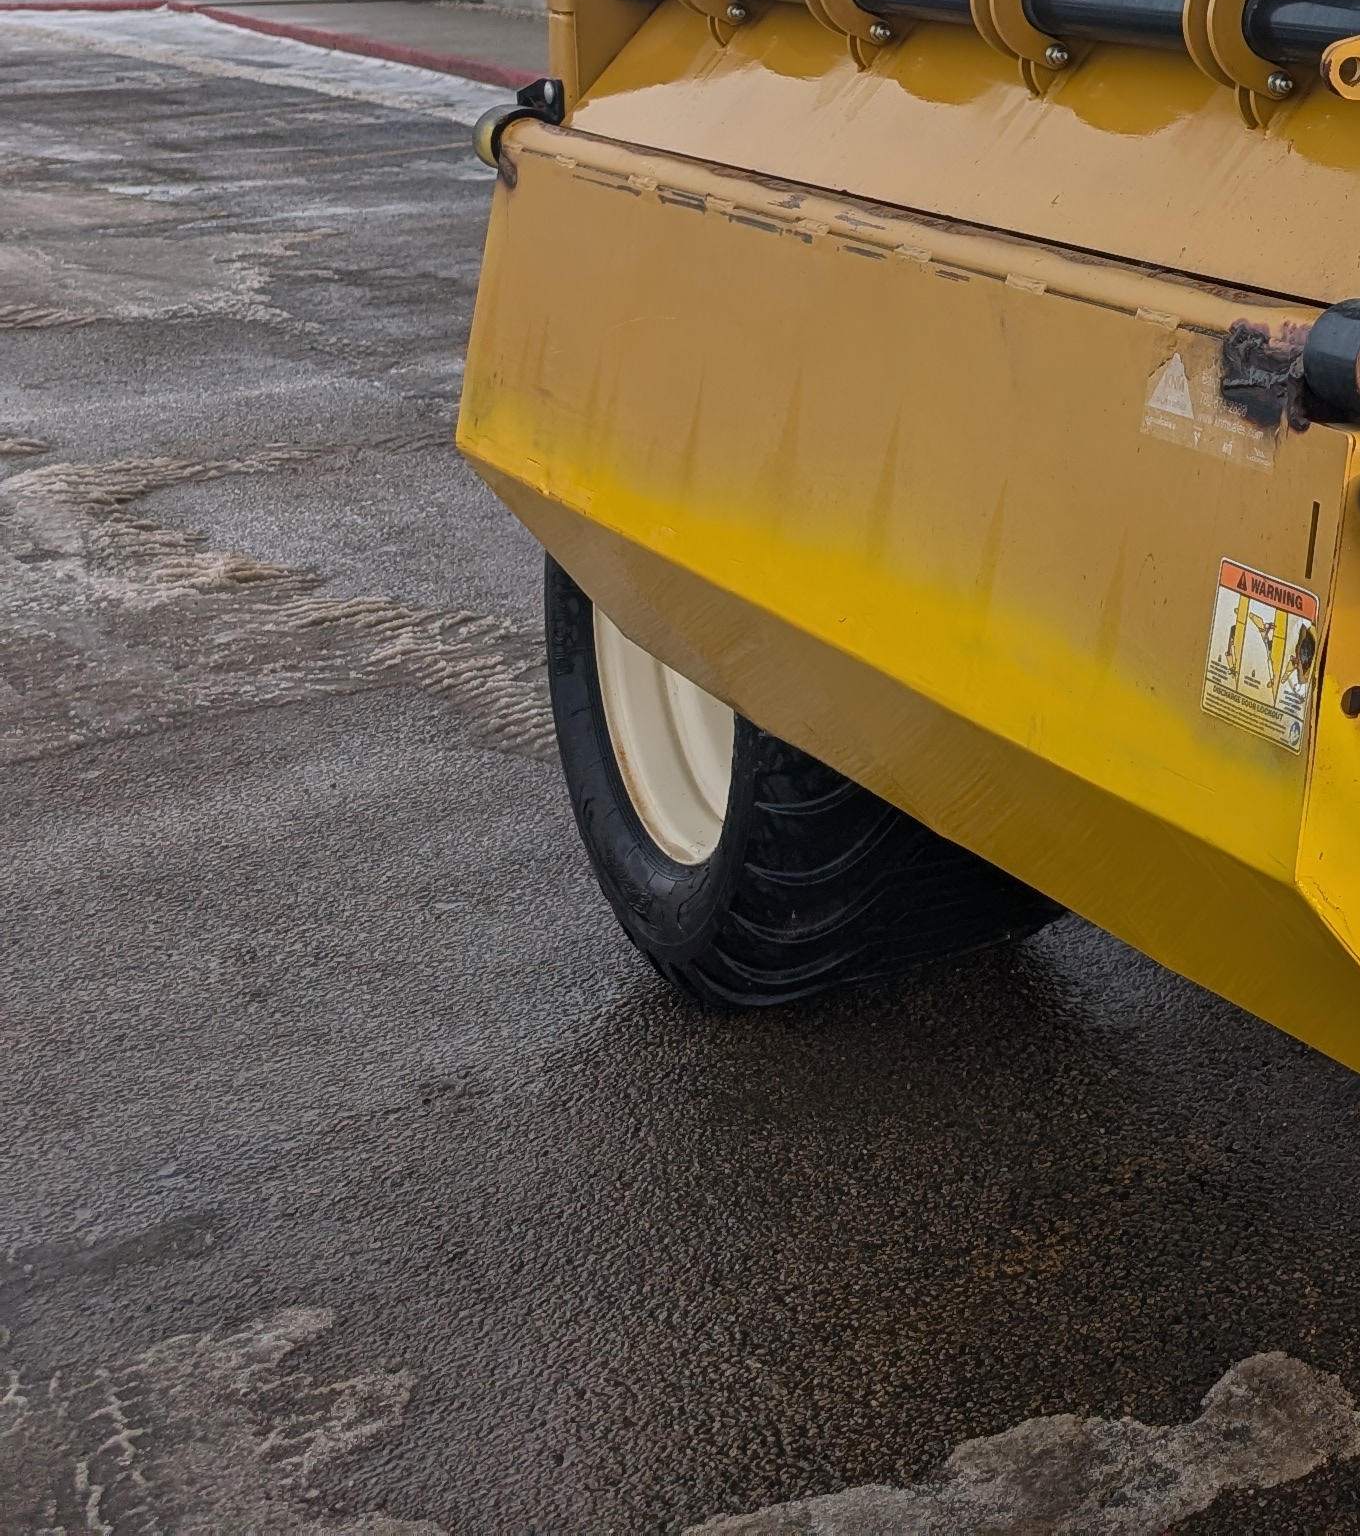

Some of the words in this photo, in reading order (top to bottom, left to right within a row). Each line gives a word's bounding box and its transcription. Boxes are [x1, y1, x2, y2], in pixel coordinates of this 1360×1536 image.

[1250, 576, 1304, 611] WARNING
[1213, 684, 1241, 704] DISCHARGE
[1240, 696, 1258, 711] DOOR
[1257, 703, 1284, 721] LOCKOUT
